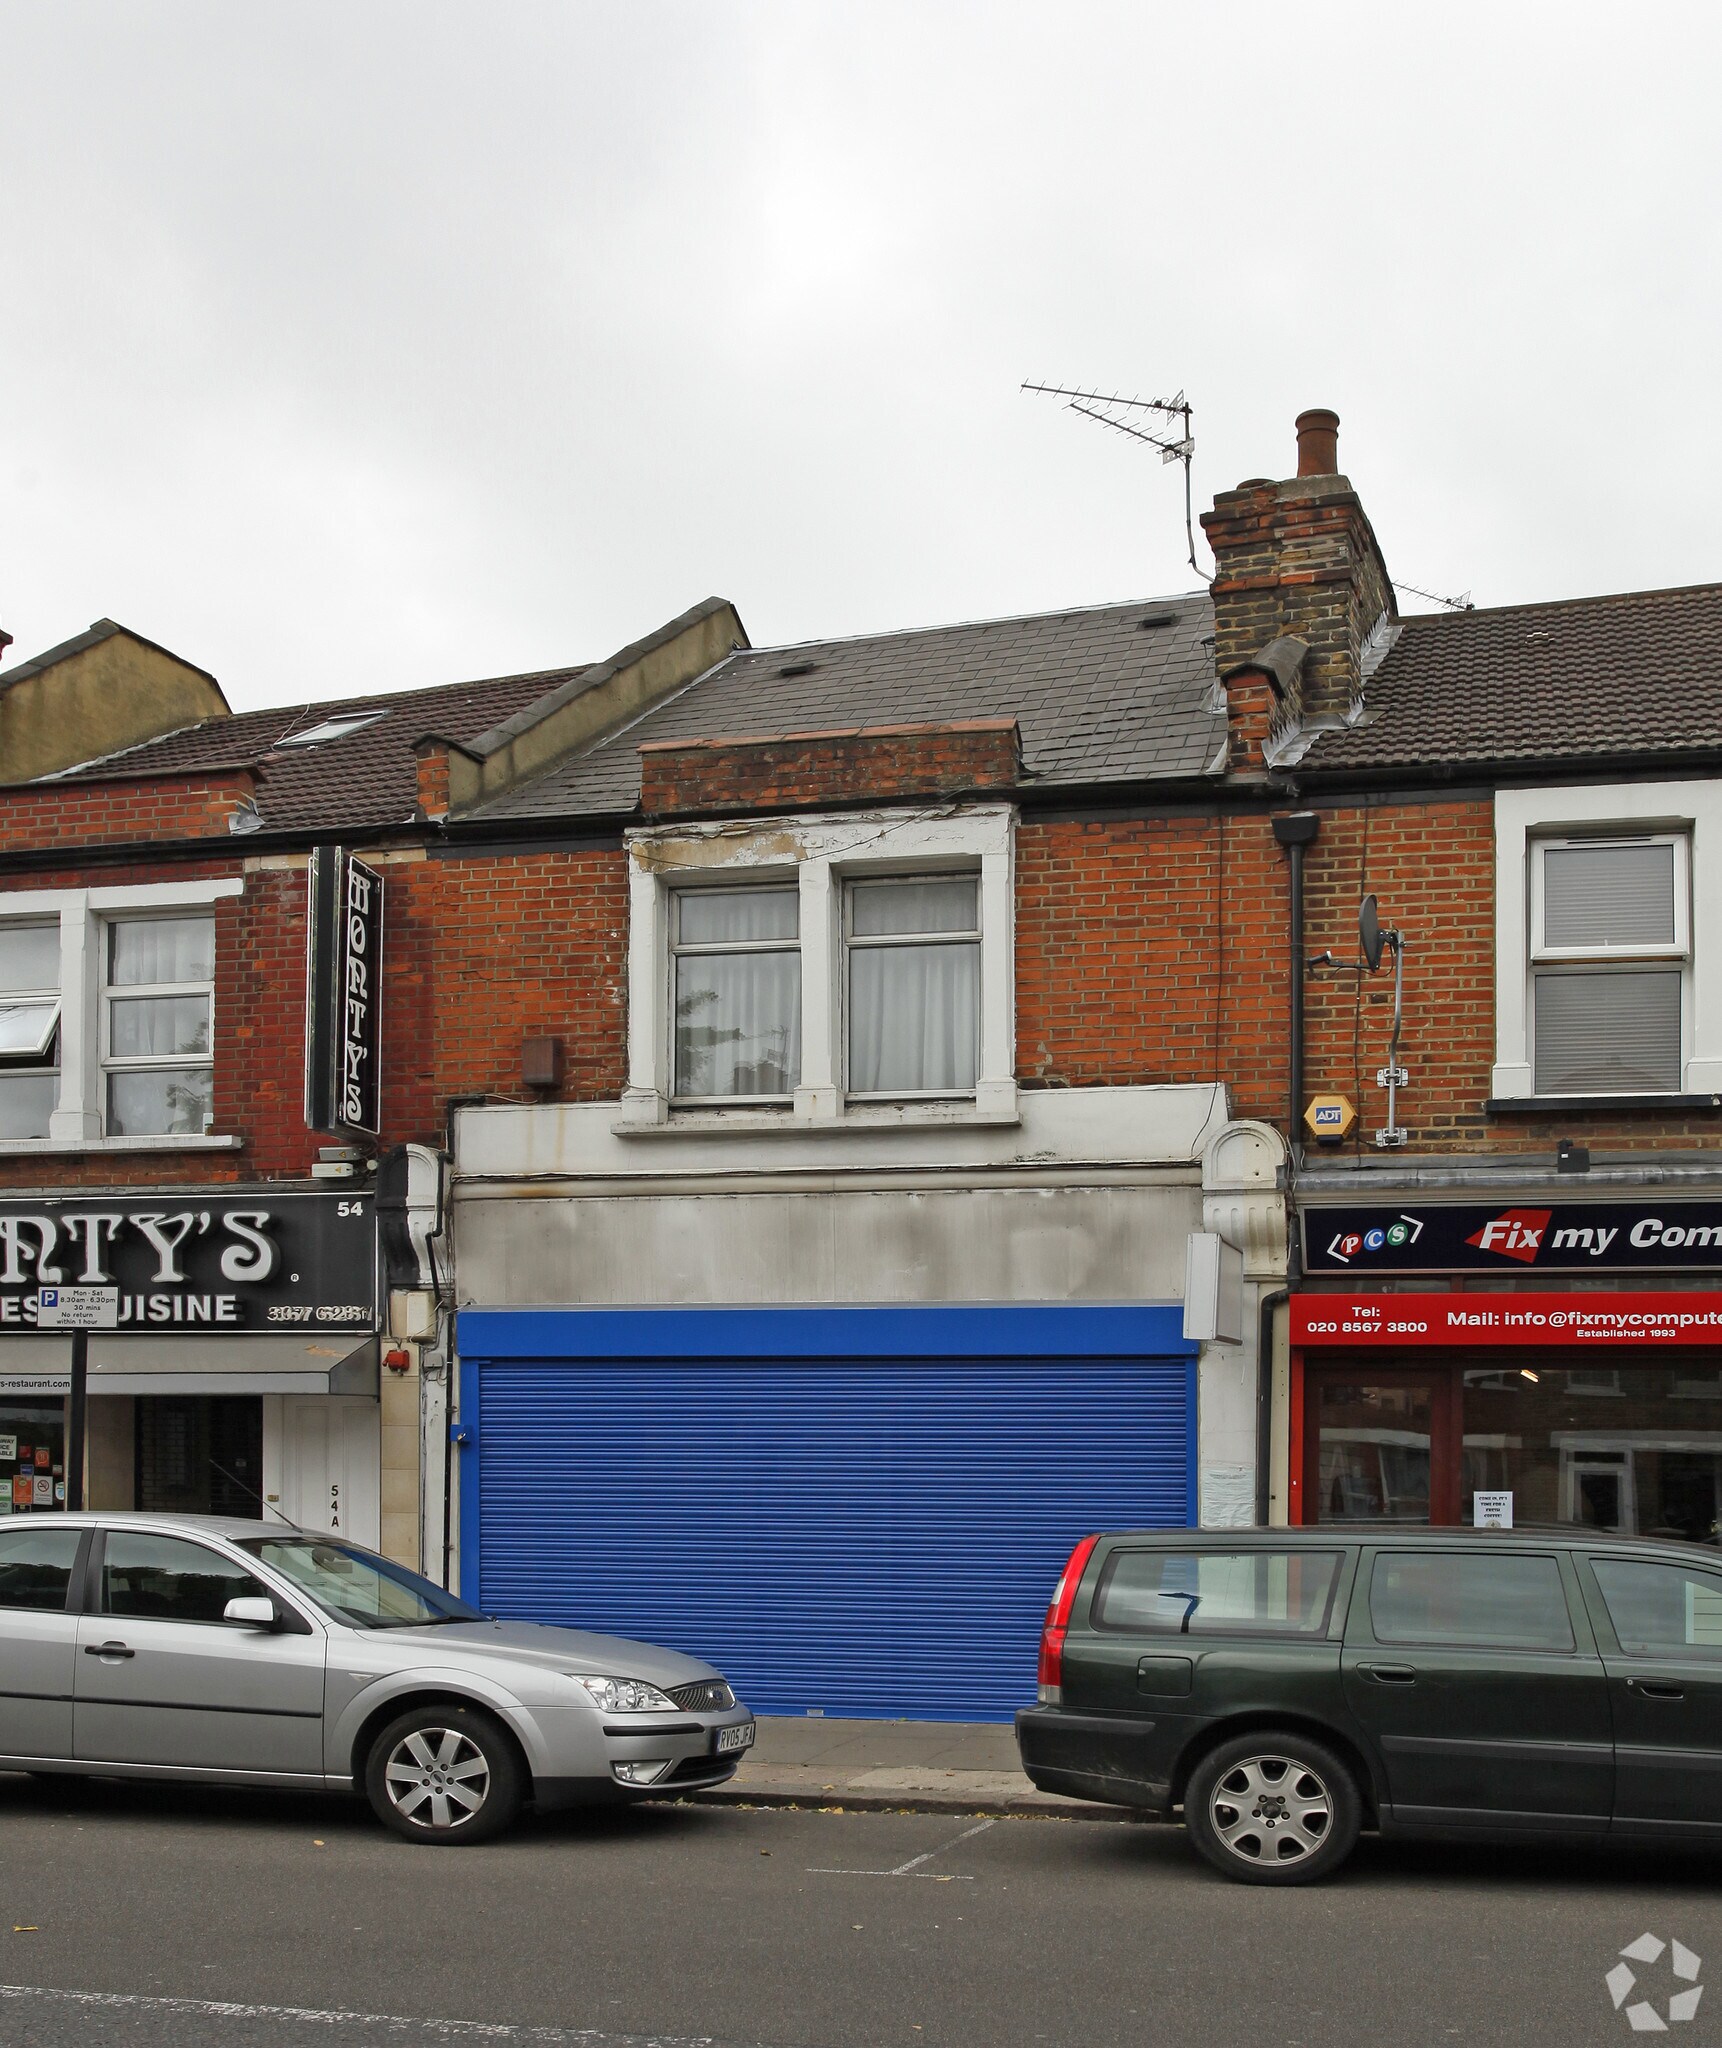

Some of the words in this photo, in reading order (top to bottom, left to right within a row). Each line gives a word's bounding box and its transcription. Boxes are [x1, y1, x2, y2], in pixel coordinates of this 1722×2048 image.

[1316, 1110, 1341, 1121] ADT
[337, 1201, 363, 1217] 54
[1344, 1223, 1406, 1254] PCS
[1479, 1220, 1543, 1249] Fix
[1551, 1227, 1619, 1256] my
[1629, 1218, 1722, 1248] Com
[44, 1291, 55, 1306] P
[118, 1294, 238, 1322] UISINE
[1352, 1306, 1380, 1317] Tel:
[1447, 1312, 1500, 1326] Mail:
[1307, 1322, 1337, 1333] 020
[1342, 1322, 1382, 1333] 8567
[1387, 1322, 1428, 1333] 3800
[1576, 1329, 1646, 1338] Established
[1650, 1329, 1676, 1338] 1993
